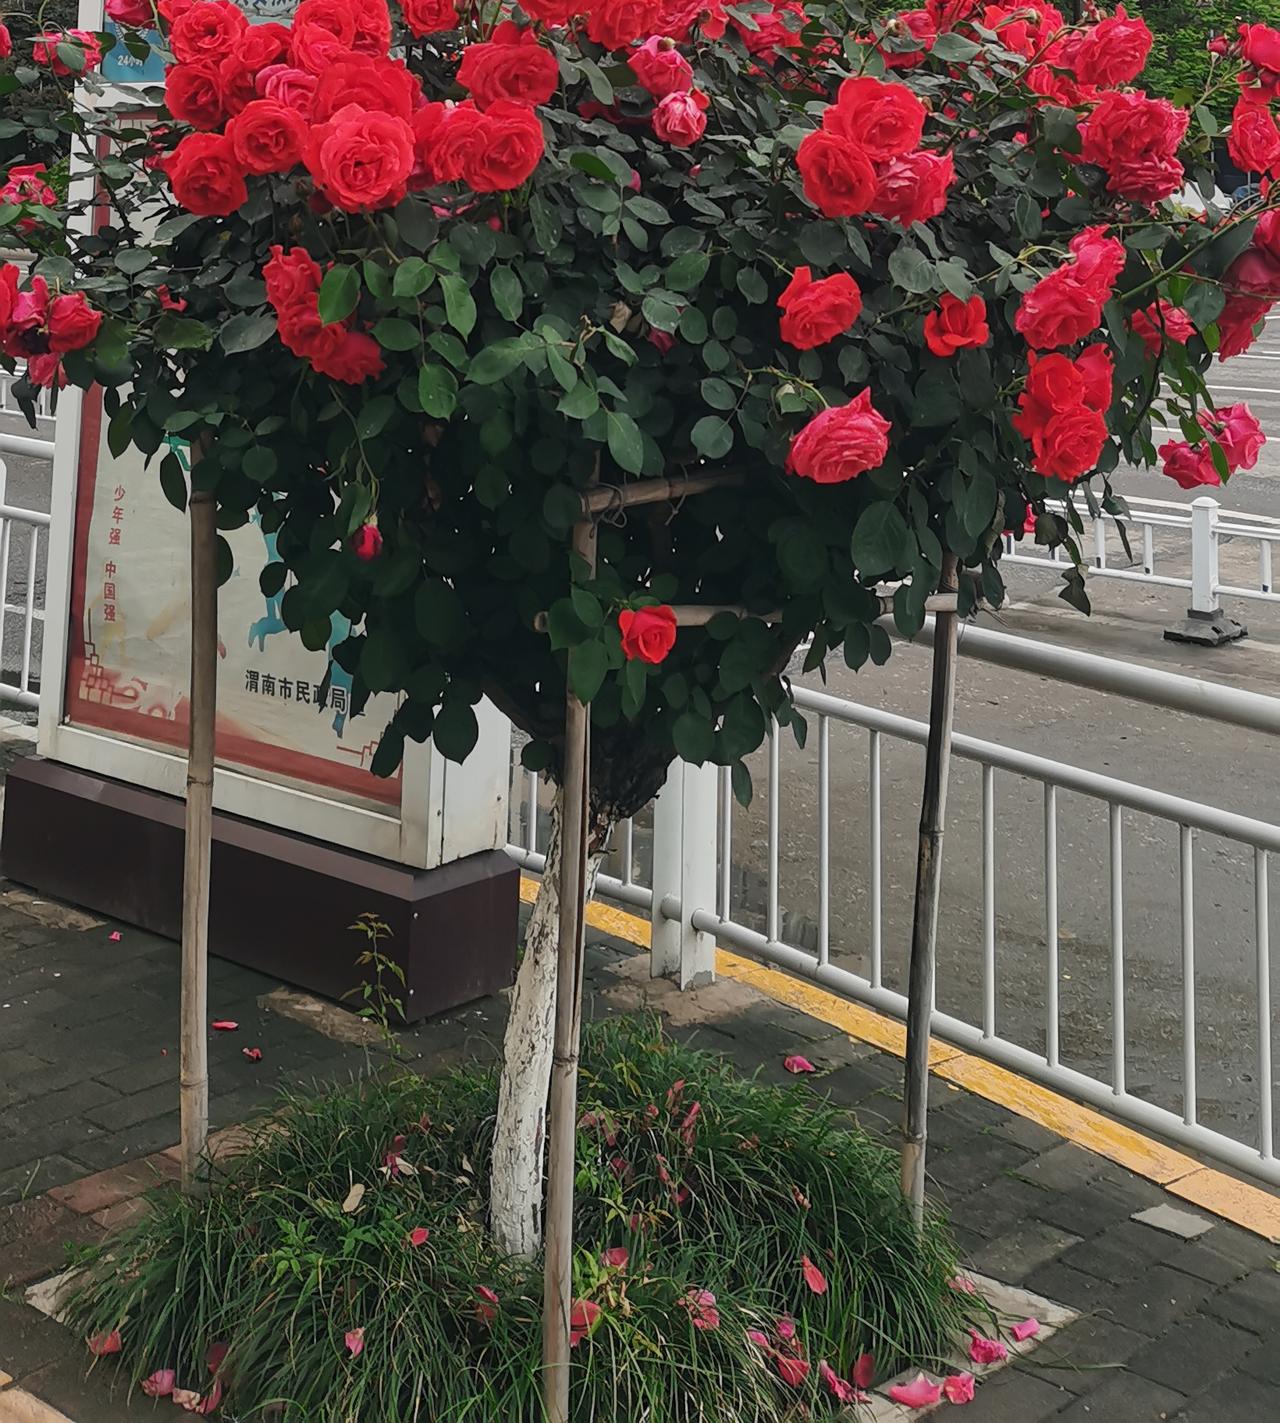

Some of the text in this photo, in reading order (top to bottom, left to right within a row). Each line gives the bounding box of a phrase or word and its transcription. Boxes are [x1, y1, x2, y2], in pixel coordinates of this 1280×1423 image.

[104, 484, 126, 621] 少年强 中国强
